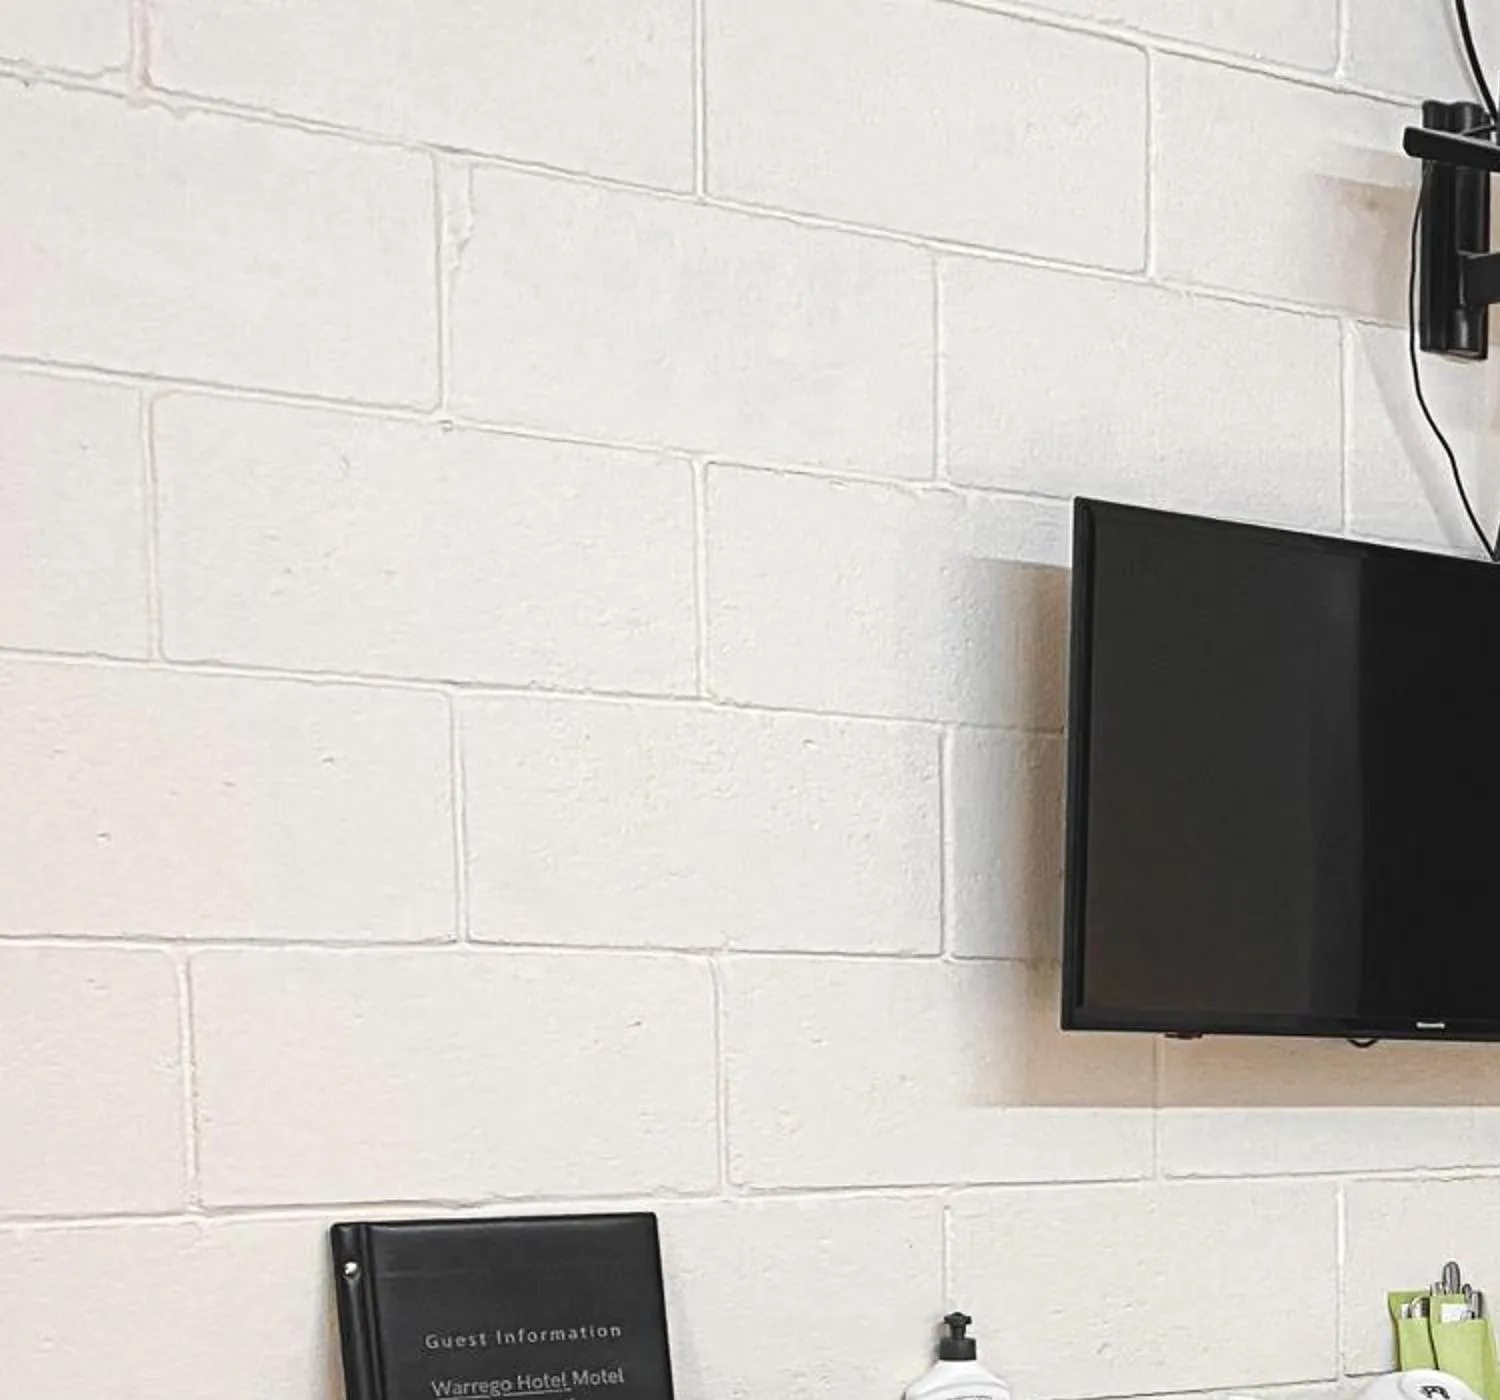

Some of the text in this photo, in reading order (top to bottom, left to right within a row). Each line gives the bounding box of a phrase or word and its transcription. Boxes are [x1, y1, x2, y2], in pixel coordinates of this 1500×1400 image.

[425, 1324, 621, 1349] Guest Information
[431, 1367, 625, 1397] Warrego Hotel Motel
